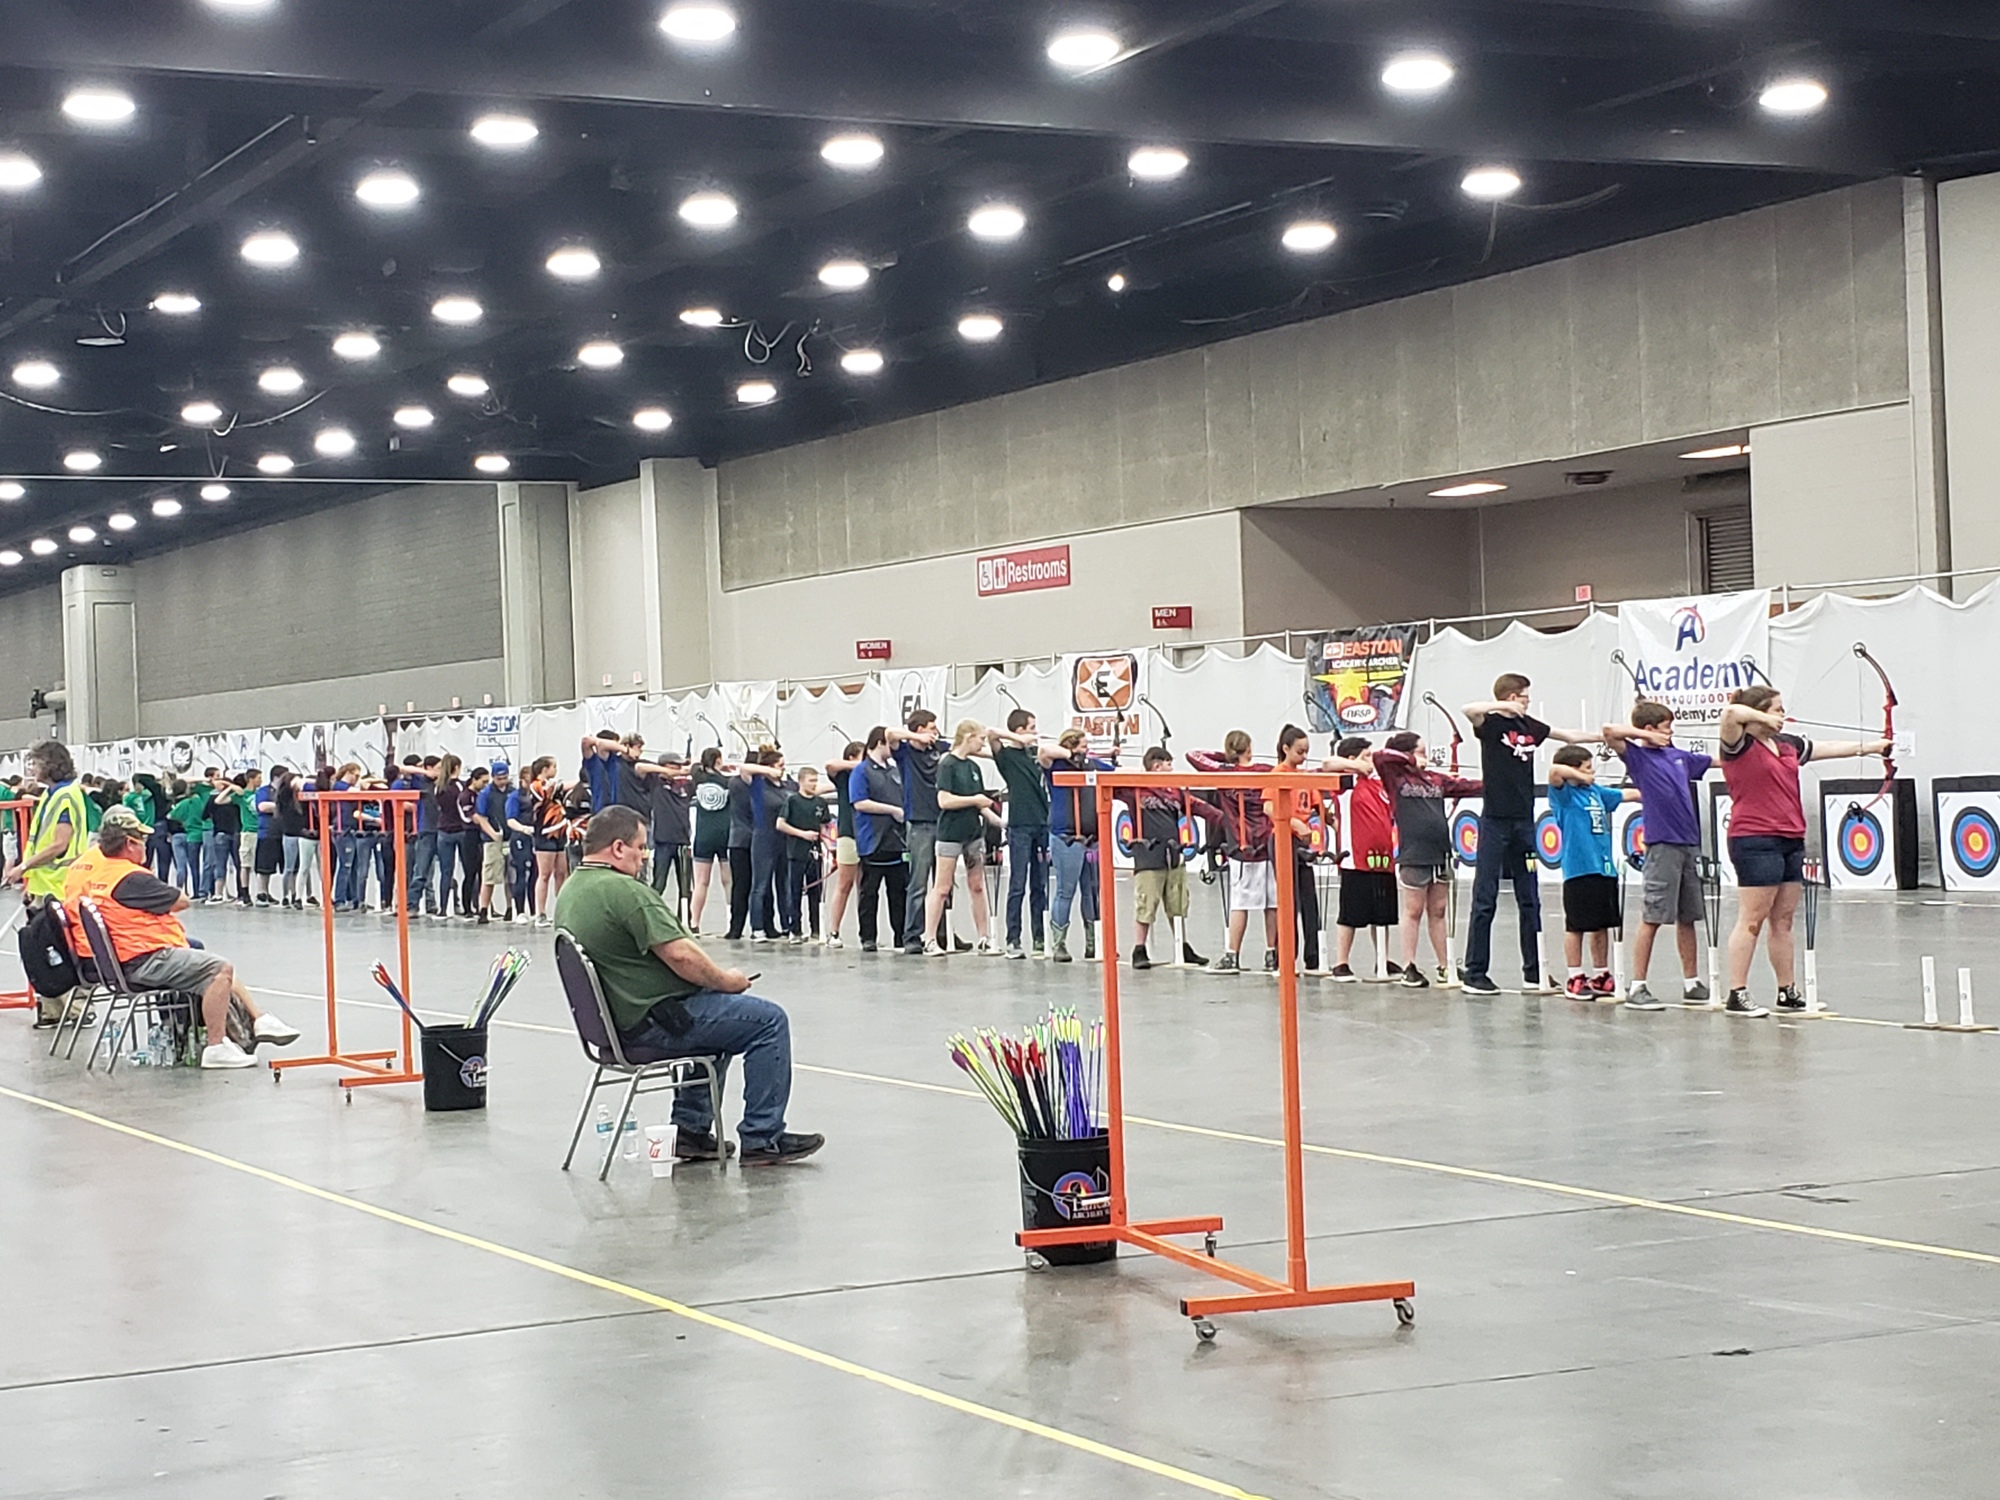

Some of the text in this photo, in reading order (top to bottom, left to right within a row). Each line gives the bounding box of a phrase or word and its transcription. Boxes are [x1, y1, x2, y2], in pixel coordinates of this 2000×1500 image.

[1008, 559, 1067, 584] Restrooms
[1155, 608, 1177, 618] MEN
[1344, 638, 1403, 656] EASTON
[1634, 656, 1756, 691] Academy
[1072, 714, 1139, 736] EASTN
